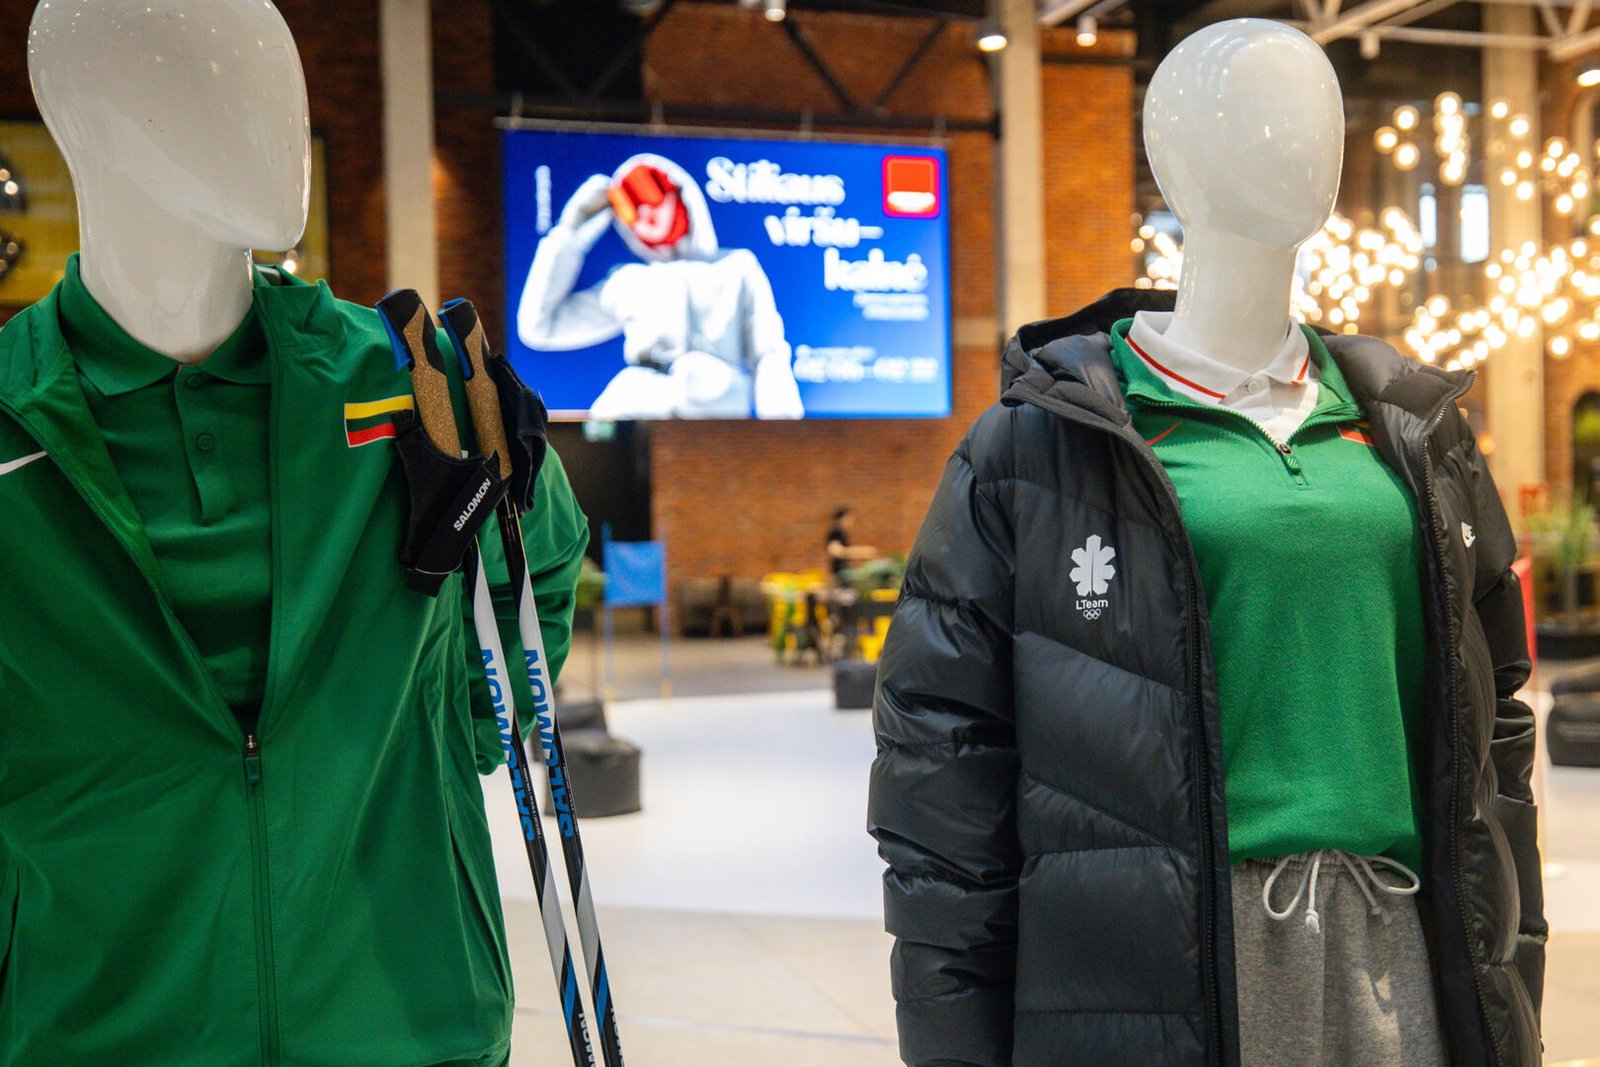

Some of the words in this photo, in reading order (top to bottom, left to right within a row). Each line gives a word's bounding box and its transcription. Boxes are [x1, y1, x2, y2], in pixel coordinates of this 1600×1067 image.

[453, 478, 491, 532] SALOMON
[1075, 599, 1109, 610] LTeam
[523, 649, 574, 838] SALOMON
